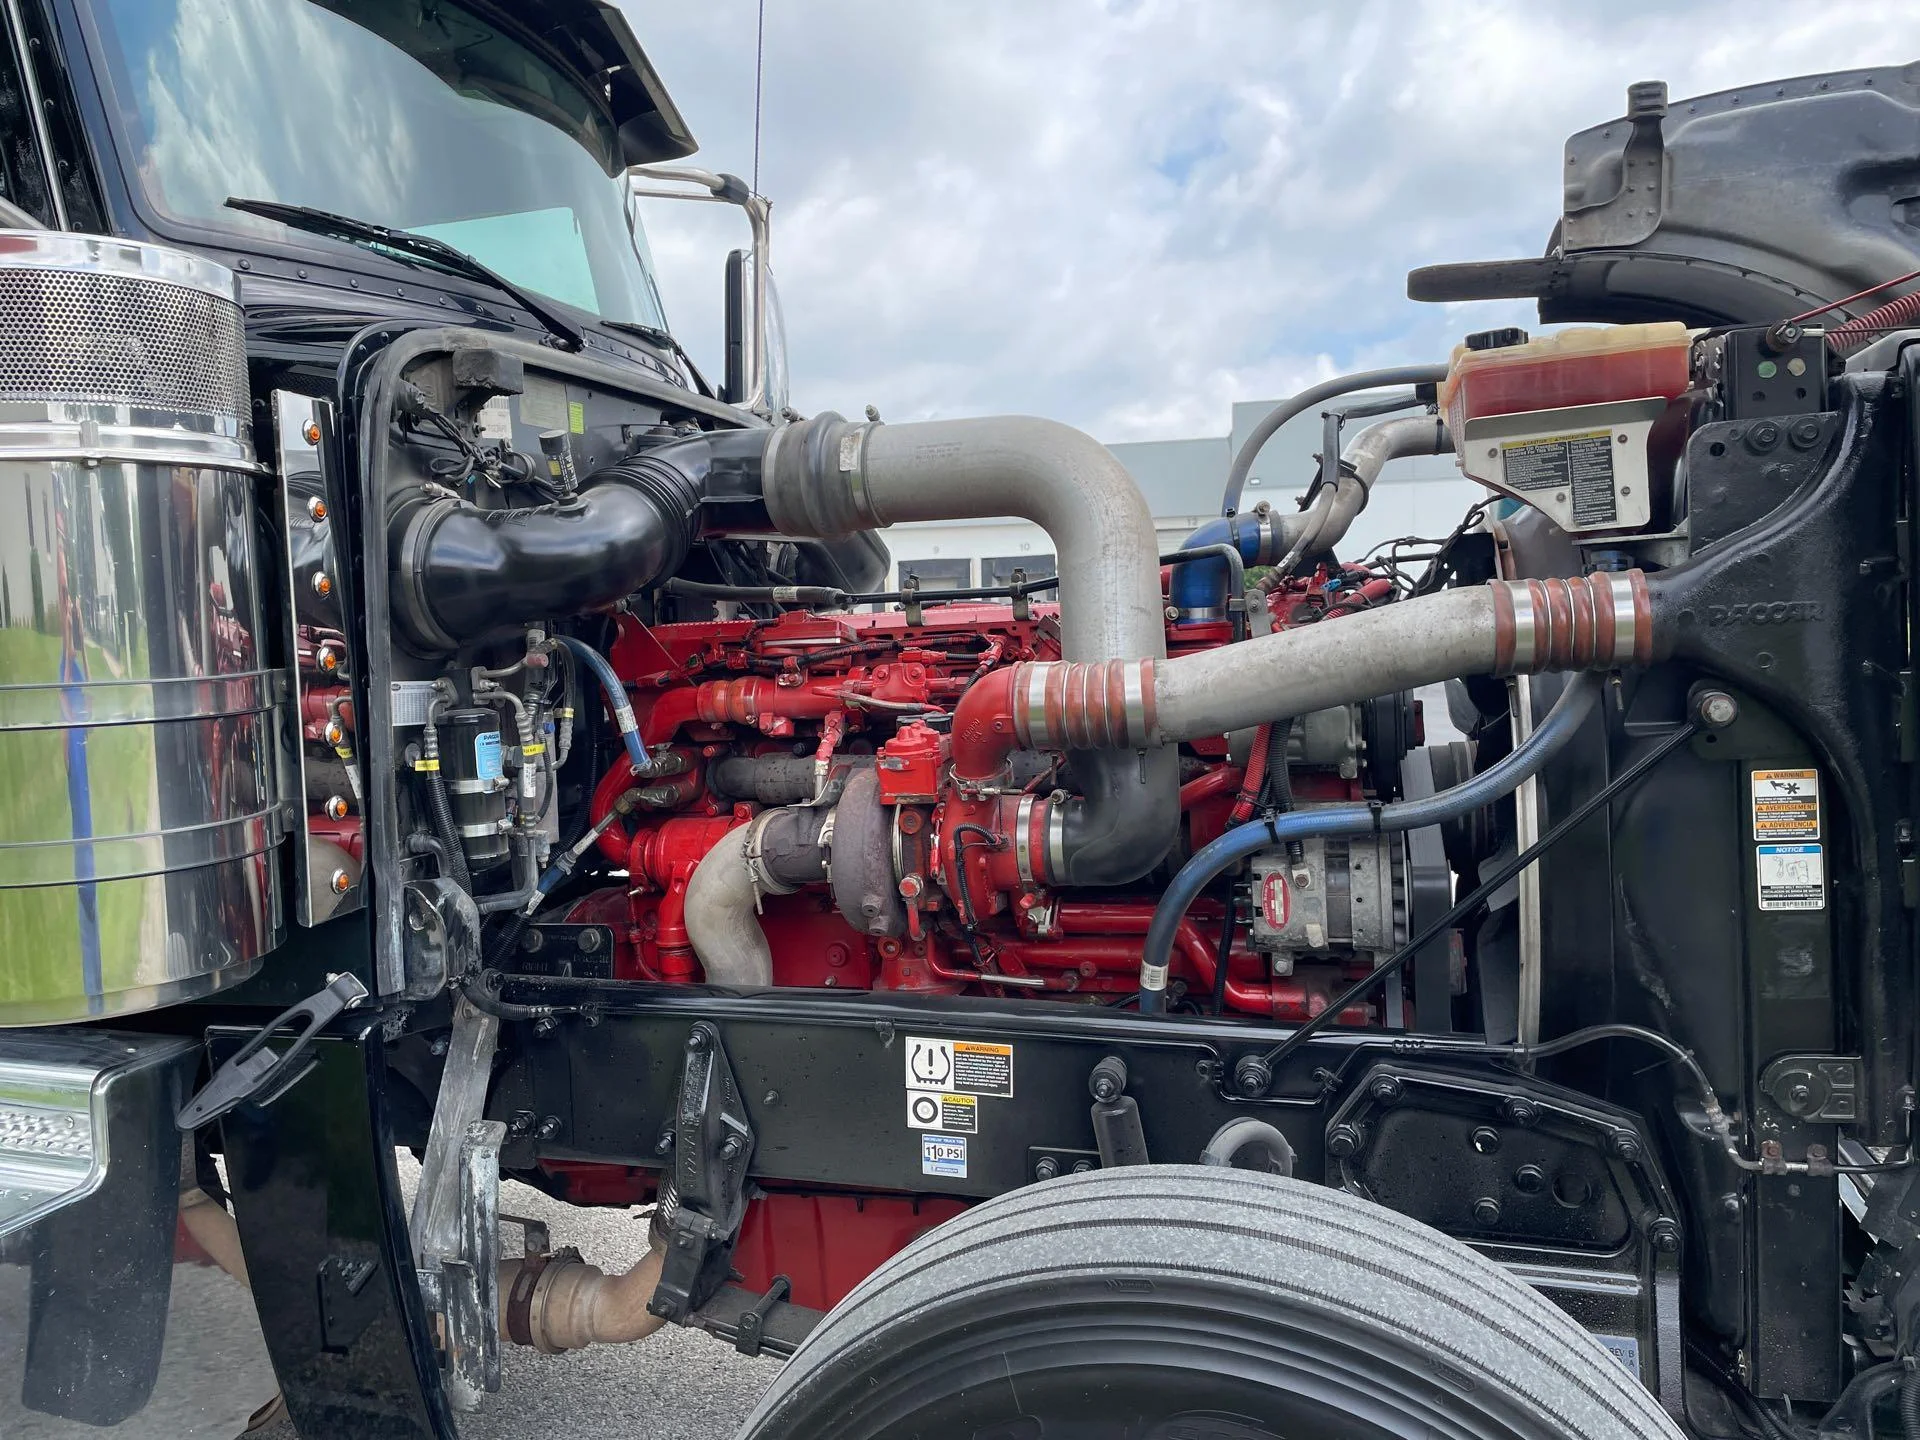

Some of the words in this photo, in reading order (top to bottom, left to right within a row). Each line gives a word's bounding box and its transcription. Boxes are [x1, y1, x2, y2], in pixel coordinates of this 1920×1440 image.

[933, 546, 939, 554] 9
[1020, 543, 1030, 552] 10
[970, 1045, 999, 1053] WARNING
[949, 1096, 975, 1104] CAUTION
[926, 1145, 943, 1160] 110
[947, 1148, 963, 1159] PSI
[1628, 1350, 1635, 1358] B
[1628, 1360, 1635, 1368] A
